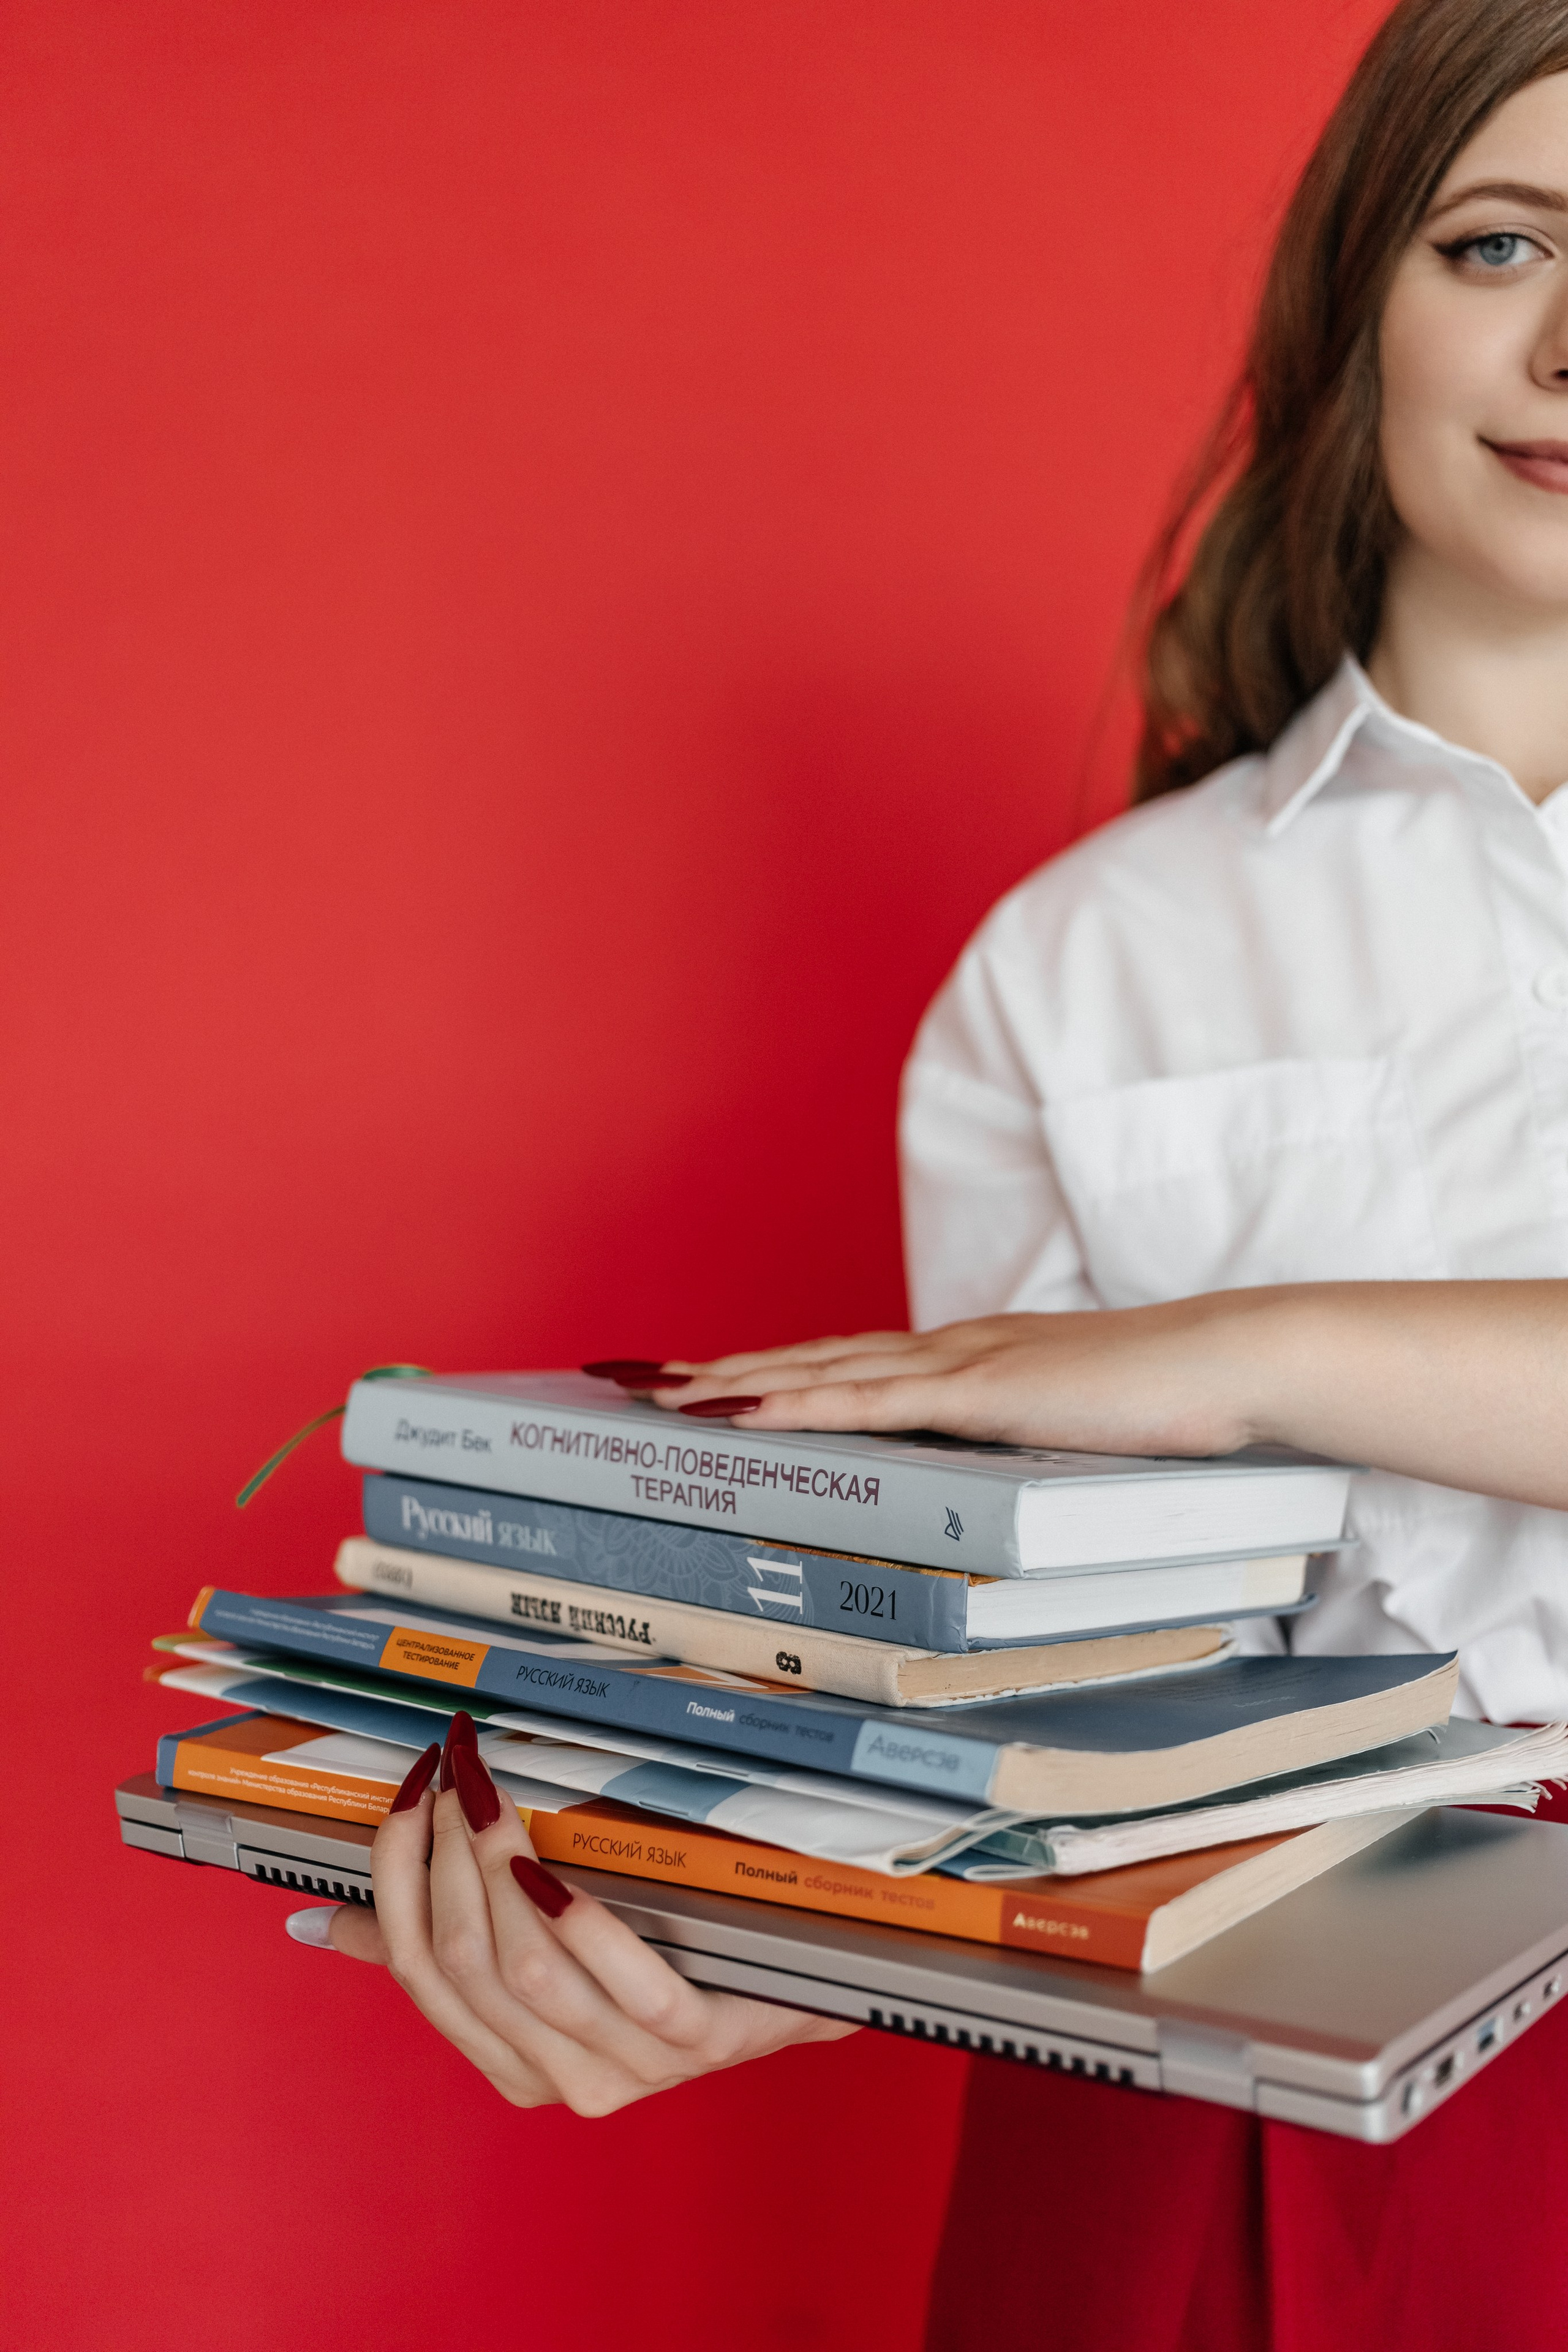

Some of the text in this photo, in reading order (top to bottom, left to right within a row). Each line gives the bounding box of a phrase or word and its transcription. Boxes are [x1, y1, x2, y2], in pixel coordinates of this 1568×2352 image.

[395, 1418, 492, 1453] Джудит Бек
[510, 1421, 880, 1506] КОГНИТИВНО-ПОВЕДЕНЧЕСКАЯ
[631, 1474, 736, 1514] ТЕРАПИЯ
[402, 1494, 557, 1556] Русский язык
[747, 1556, 802, 1615] 11
[840, 1581, 897, 1620] 2021
[511, 1593, 652, 1645] РУССКИЙ ЯЗЫК
[396, 1638, 475, 1661] ЦЕНТРАЛИЗОВАННОЕ
[403, 1651, 460, 1670] ТЕСТИРОВАНИЕ
[516, 1665, 611, 1698] РУССКИЙ ЯЗЫК
[687, 1702, 735, 1722] Полный
[739, 1713, 790, 1733] сборник
[328, 1795, 367, 1809] Республики
[573, 1833, 687, 1868] РУССКИЙ ЯЗЫК
[735, 1861, 935, 1910] Полный сборник тестов
